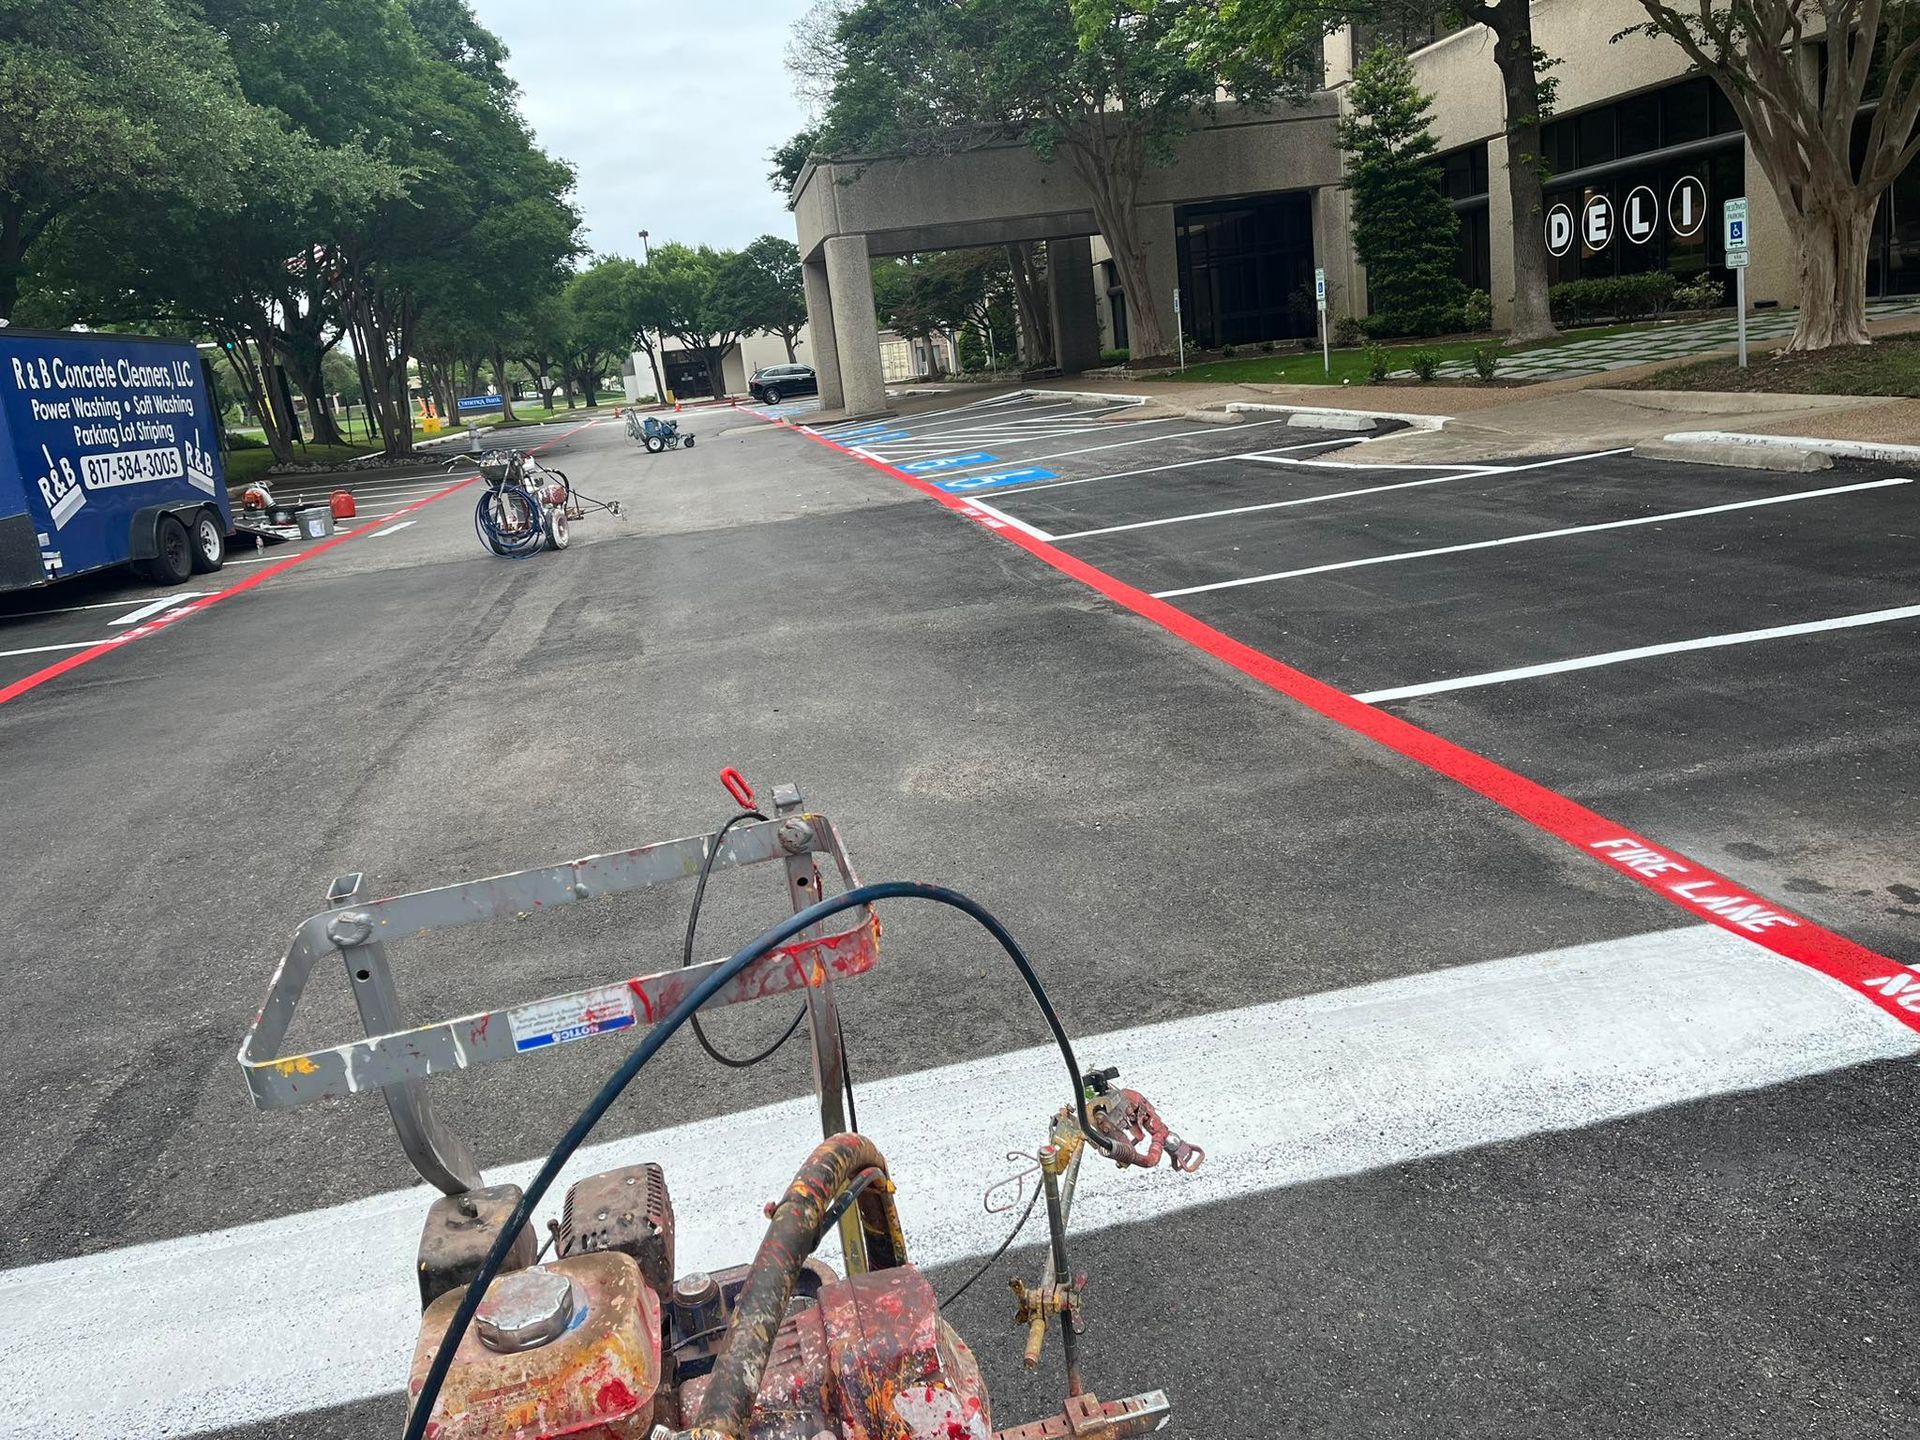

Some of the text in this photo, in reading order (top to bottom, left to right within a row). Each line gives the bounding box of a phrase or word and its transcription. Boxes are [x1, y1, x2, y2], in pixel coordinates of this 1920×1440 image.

[1551, 186, 1692, 248] DELI
[12, 357, 194, 390] R & B Concrete Cleaners, LLC
[31, 394, 194, 420] Power Washing Soft Washing
[74, 420, 175, 448] Parking Lot Striping
[87, 451, 178, 486] 817-584-3005
[185, 440, 214, 477] R&B
[38, 457, 76, 509] R&B
[1590, 838, 1799, 933] FIRE LANE
